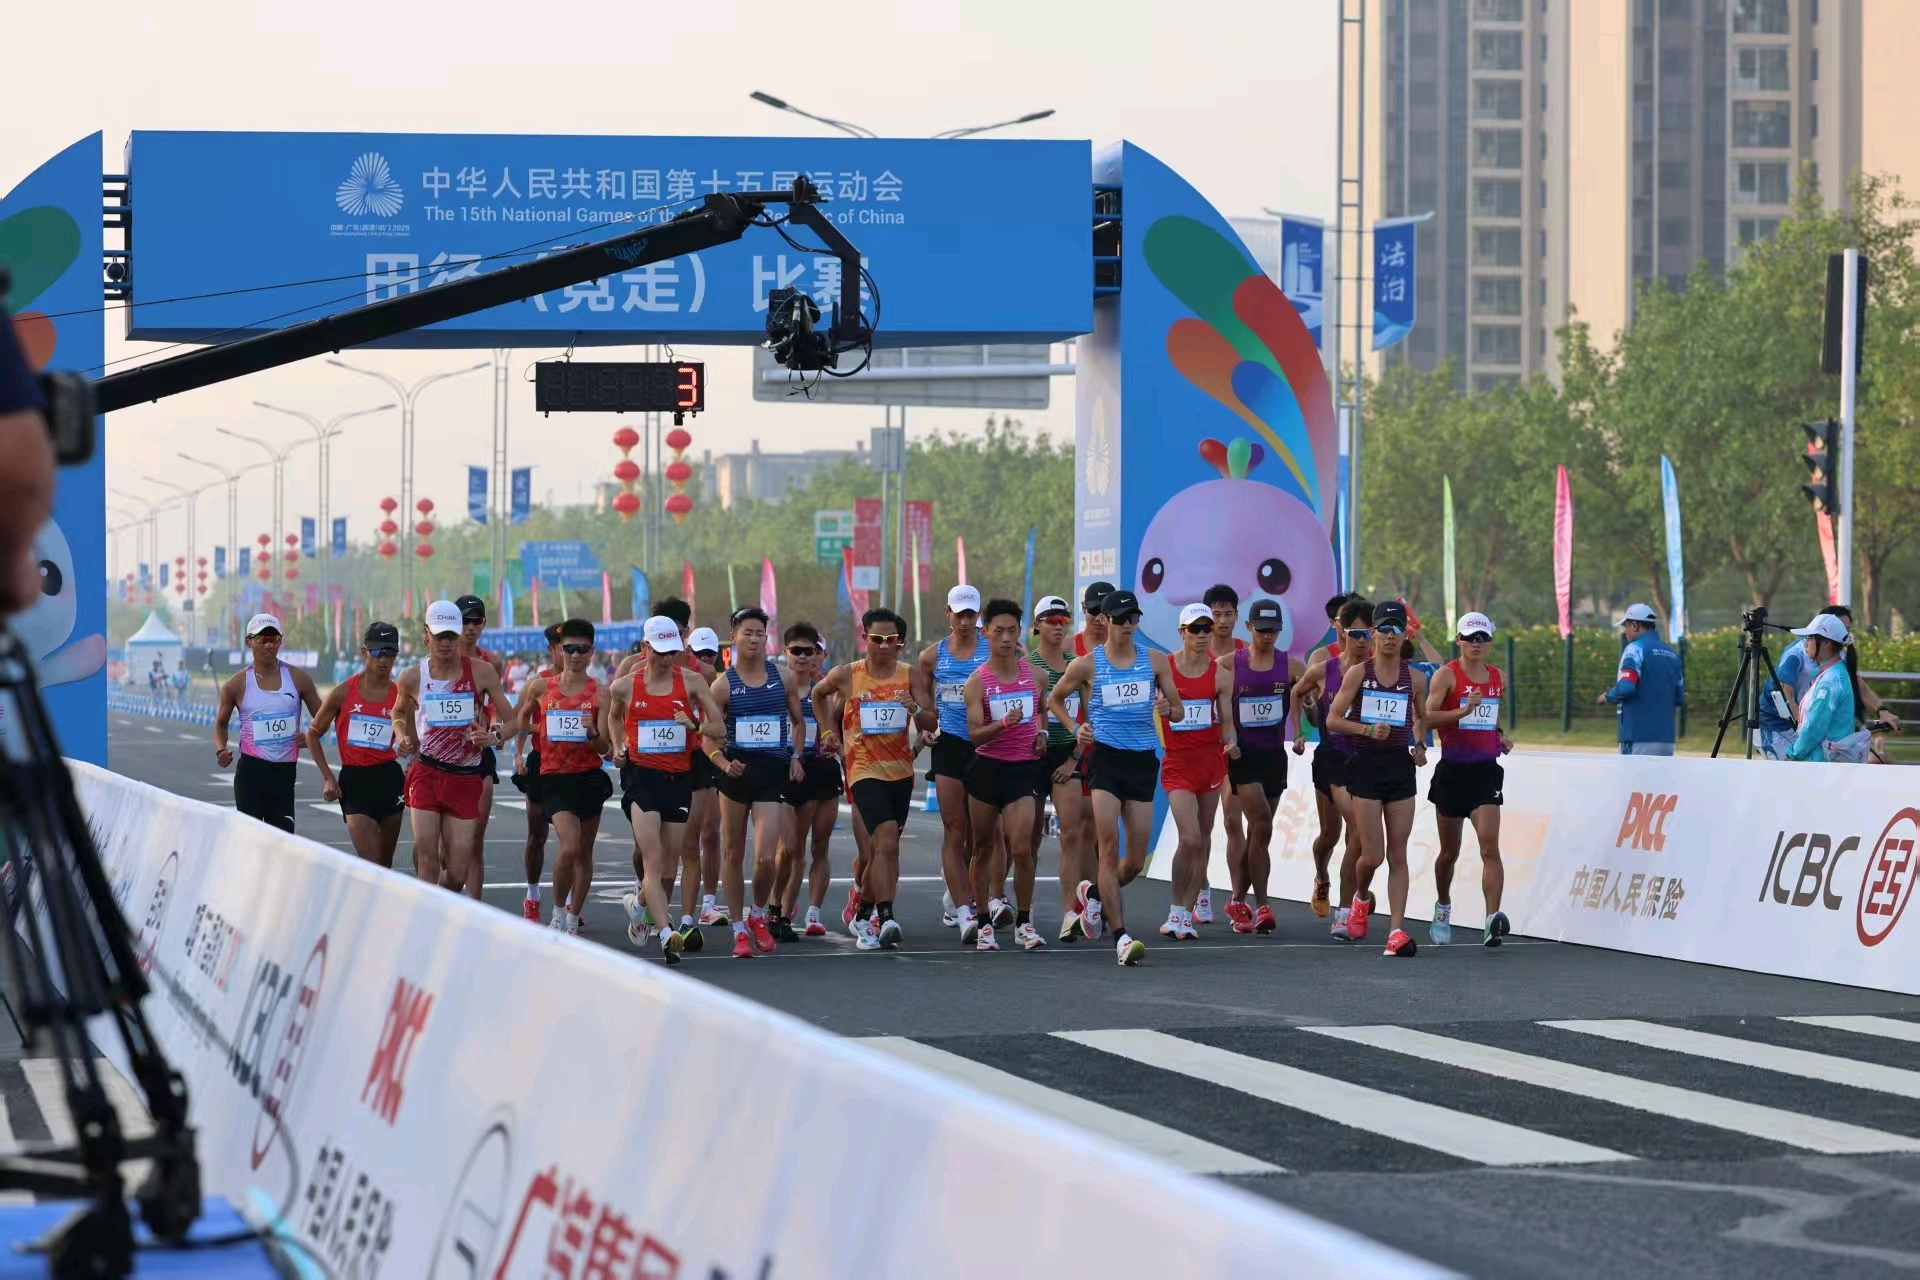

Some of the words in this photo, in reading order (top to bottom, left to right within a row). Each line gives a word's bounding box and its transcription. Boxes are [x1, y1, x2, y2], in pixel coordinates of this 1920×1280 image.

[422, 166, 903, 202] 中华人民共和国第十五届运动会
[423, 205, 454, 221] The
[460, 205, 497, 222] 15th
[502, 206, 571, 222] National
[576, 208, 634, 224] Games
[637, 209, 655, 223] of
[763, 209, 833, 228] Repc
[838, 209, 856, 224] of
[859, 209, 905, 224] China
[677, 367, 695, 407] 3
[658, 631, 677, 640] CHINA
[952, 684, 965, 697] 12
[1115, 683, 1139, 698] 128
[439, 700, 462, 714] 155
[1187, 706, 1202, 719] 17
[1251, 702, 1273, 716] 109
[1376, 699, 1397, 713] 112
[873, 708, 896, 721] 137
[265, 719, 287, 733] 160
[362, 722, 384, 737] 157
[558, 717, 579, 730] 152
[749, 722, 771, 736] 142
[651, 727, 675, 741] 146
[1615, 791, 1679, 853] PICC
[1758, 830, 1862, 911] ICBC
[1568, 864, 1686, 921] 中国人民保险
